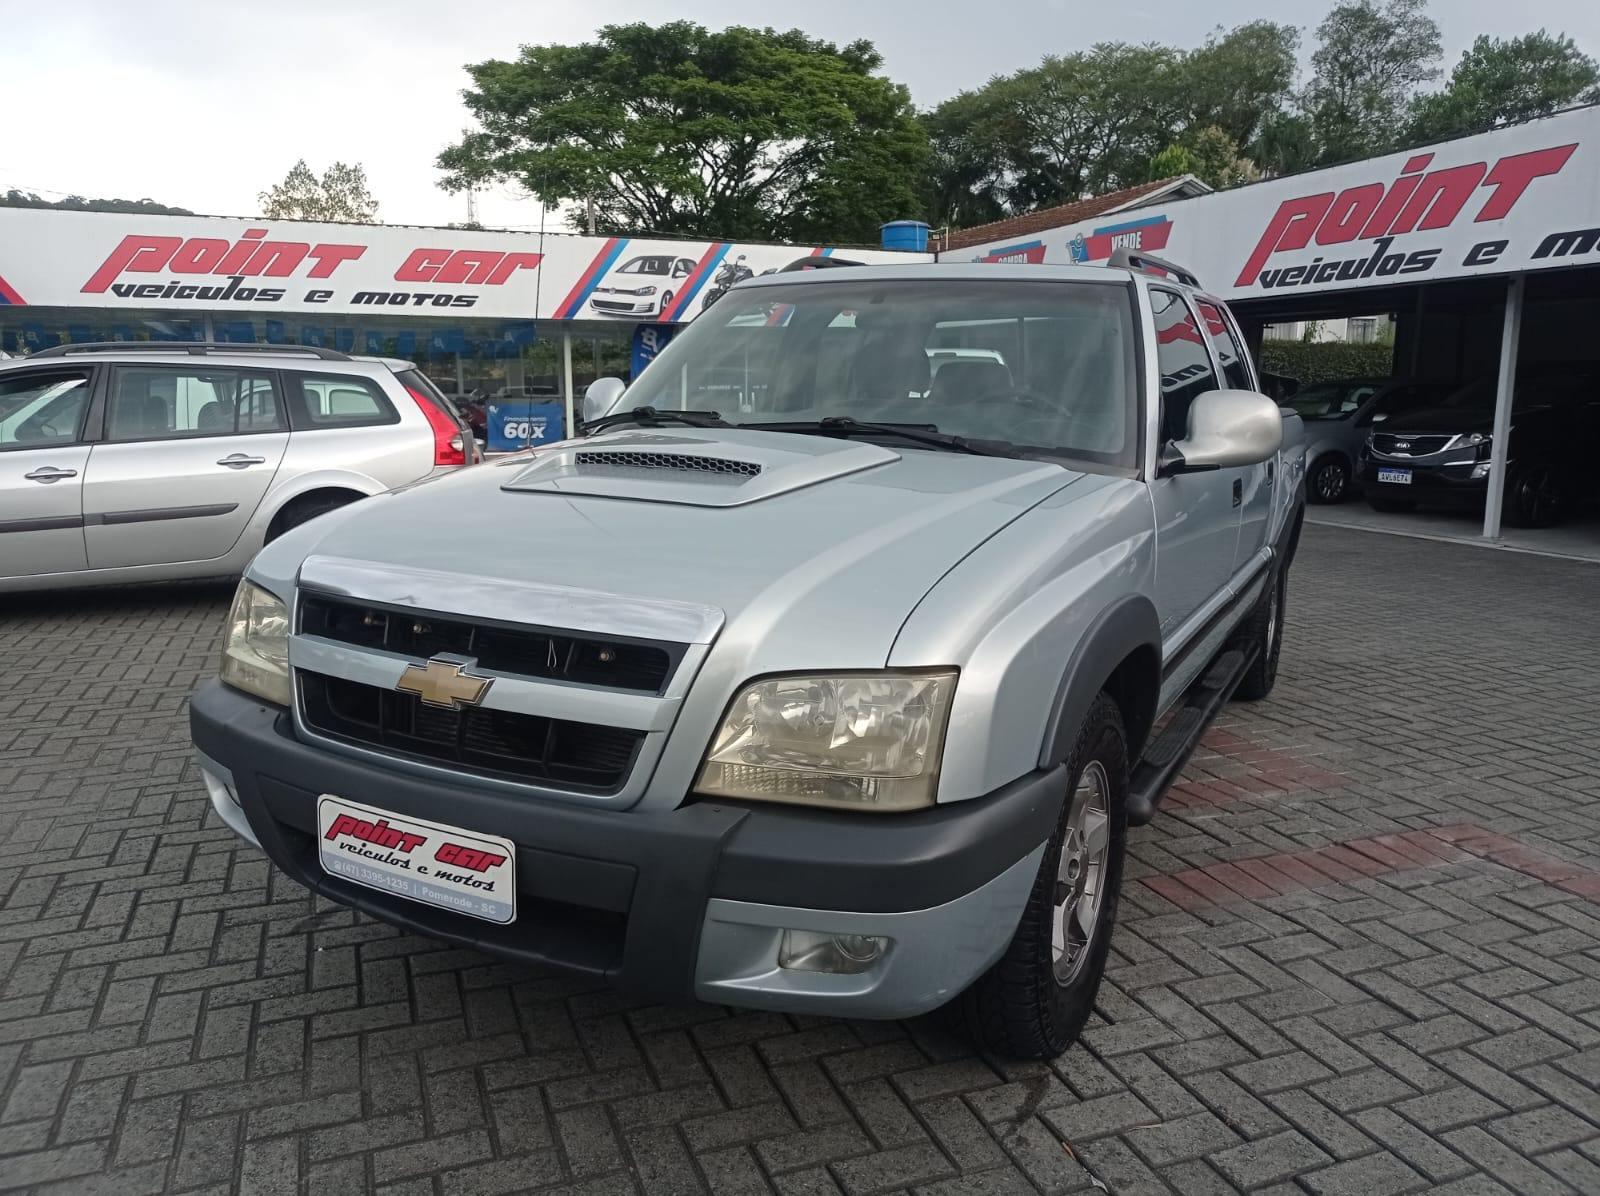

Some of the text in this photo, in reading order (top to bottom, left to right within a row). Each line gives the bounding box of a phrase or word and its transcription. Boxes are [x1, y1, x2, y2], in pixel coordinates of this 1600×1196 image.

[1111, 231, 1142, 253] VENDE
[1259, 236, 1443, 289] veiculos
[1462, 239, 1510, 266] e
[111, 276, 288, 302] veiculos
[303, 289, 334, 304] e
[339, 842, 496, 892] veiculos e motos
[422, 887, 473, 908] Pomerode
[481, 903, 497, 914] SC
